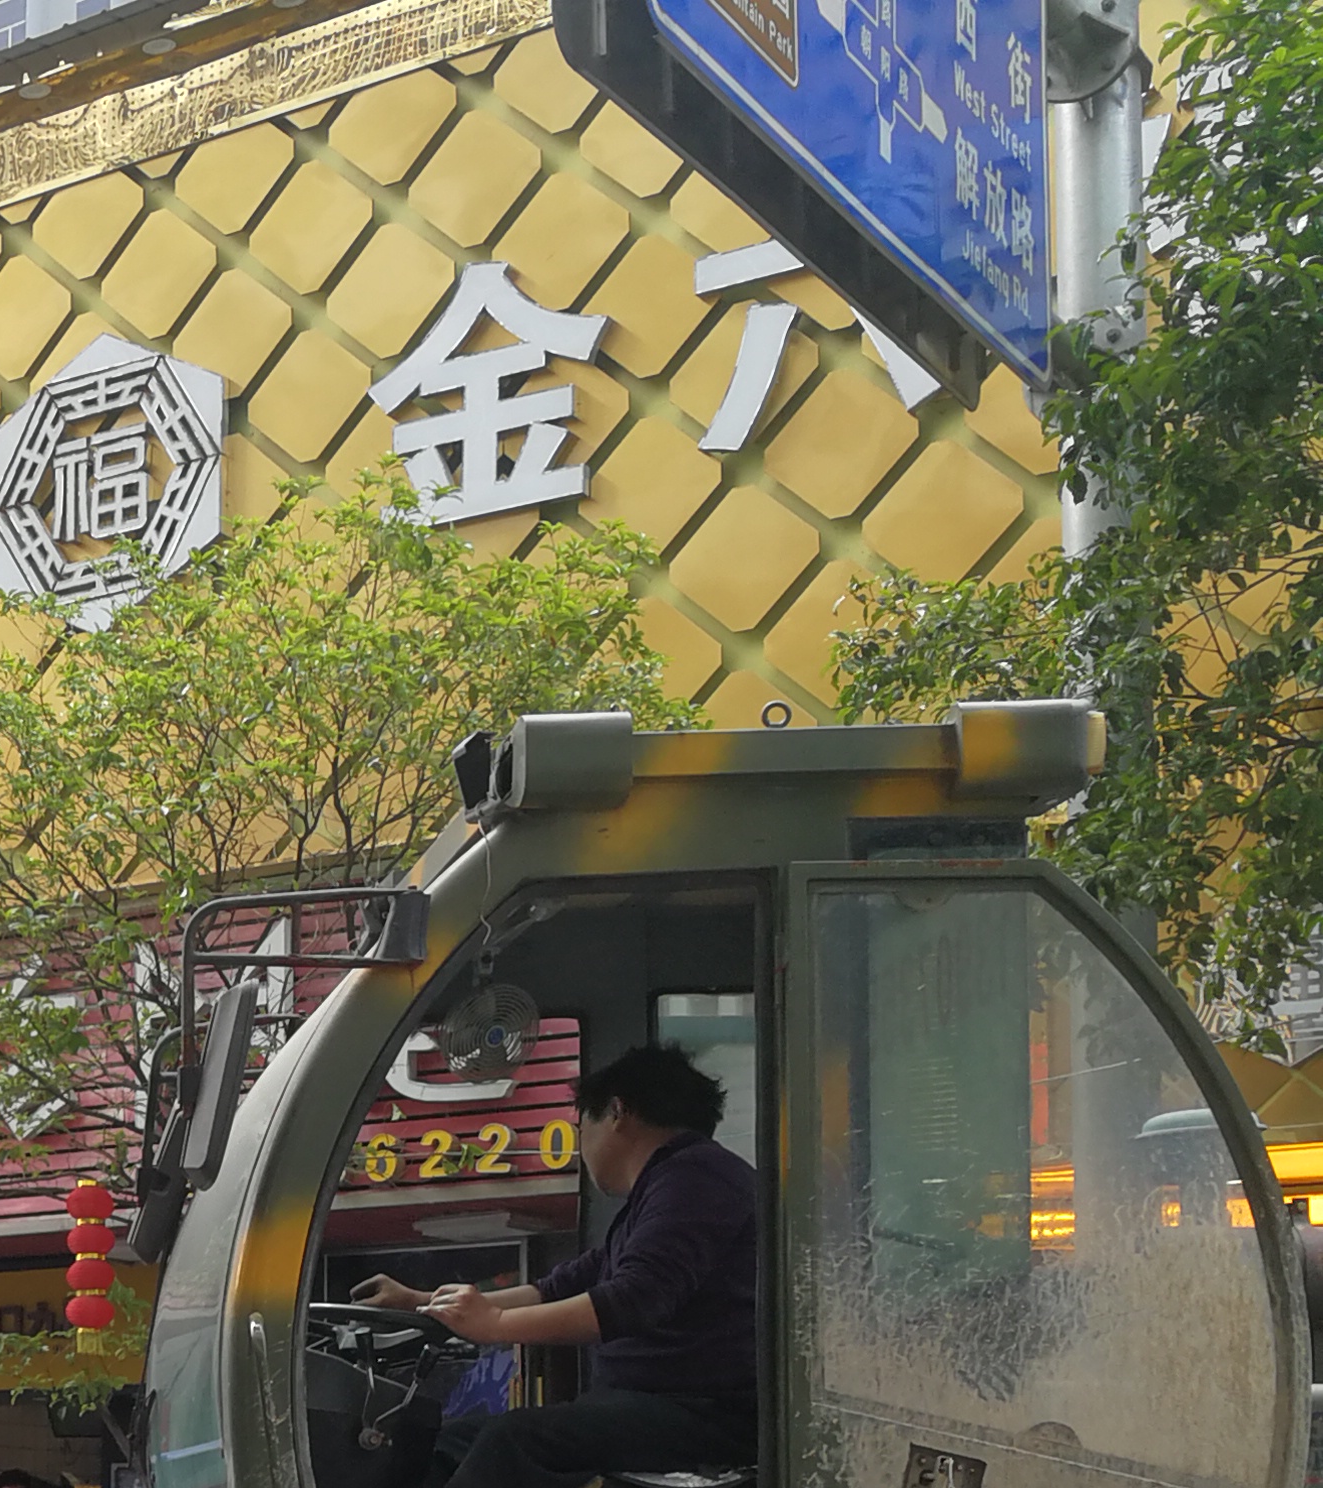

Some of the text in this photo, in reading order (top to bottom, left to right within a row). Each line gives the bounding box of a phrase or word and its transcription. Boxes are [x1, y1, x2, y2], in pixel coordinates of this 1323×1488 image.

[769, 20, 793, 62] Park
[954, 60, 1031, 172] West Street
[955, 126, 1035, 277] 解放路
[961, 229, 1009, 309] Jiefang
